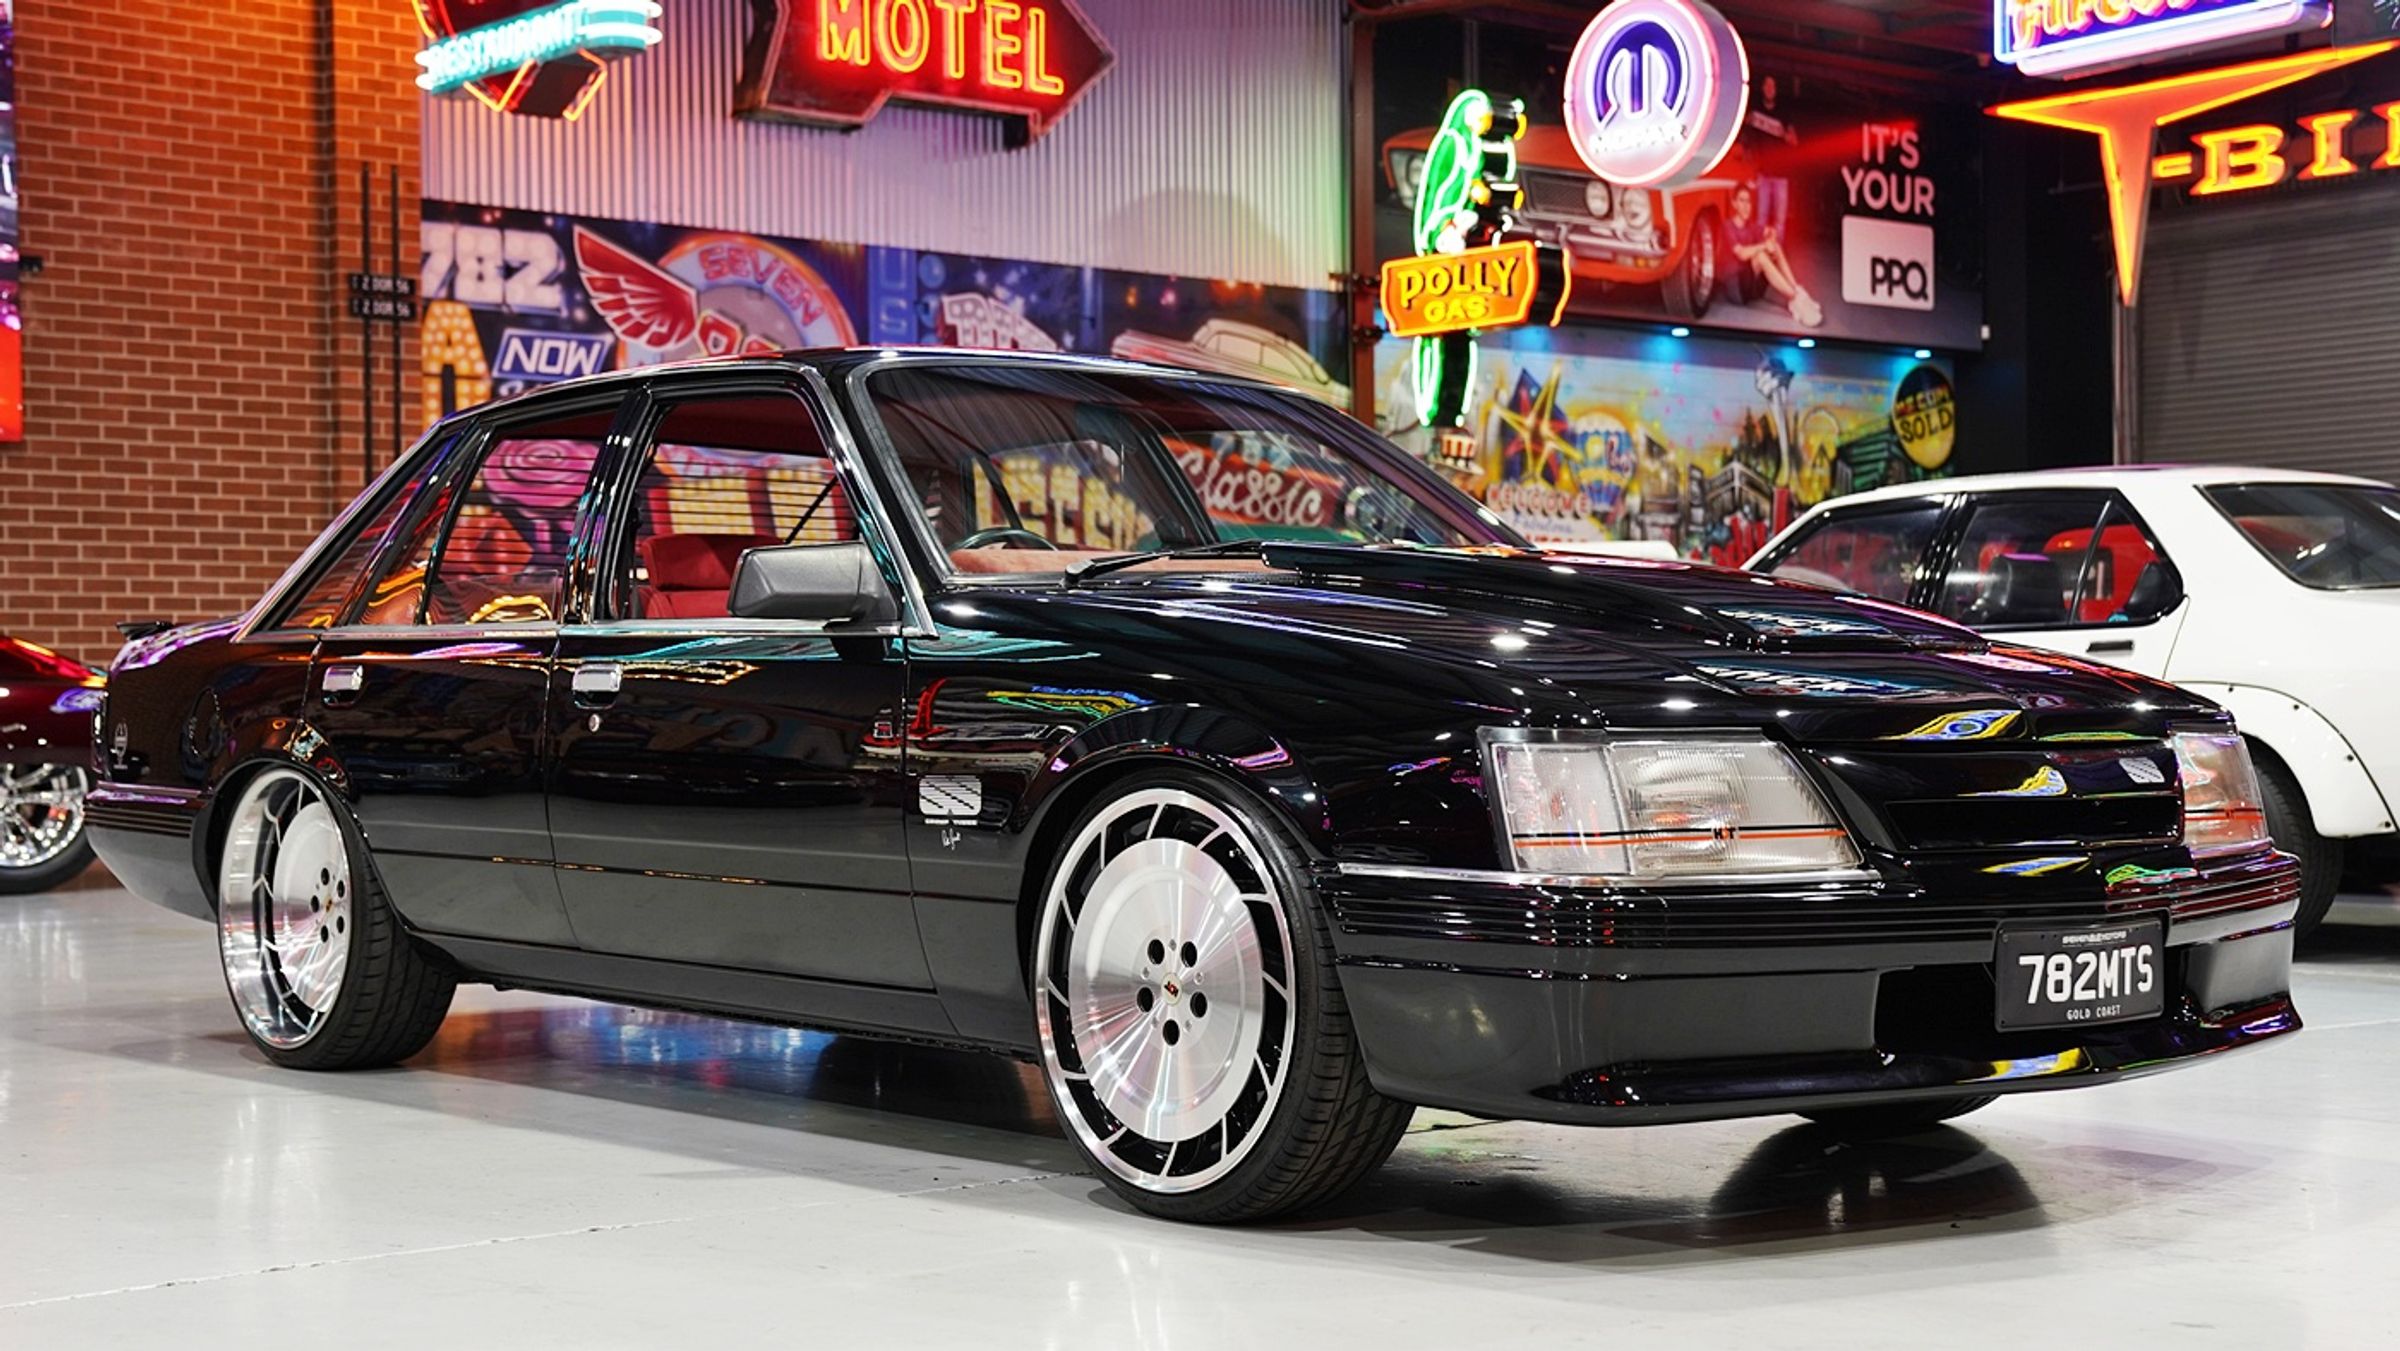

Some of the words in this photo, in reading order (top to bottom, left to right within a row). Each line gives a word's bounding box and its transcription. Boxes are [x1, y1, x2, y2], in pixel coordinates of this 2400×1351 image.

[819, 0, 1064, 96] MOTEL
[1861, 122, 1920, 170] IT'S
[1840, 165, 1935, 216] YOUR
[421, 221, 567, 316] 782
[698, 246, 825, 327] SEVEN
[1396, 256, 1521, 311] POLLY
[1871, 255, 1929, 301] PPQ
[1423, 294, 1491, 324] GAS
[501, 336, 602, 376] NOW
[1900, 407, 1952, 443] SOLD
[1176, 450, 1324, 528] Classic
[2018, 944, 2153, 1004] 782MTS
[2065, 1008, 2092, 1021] GOLD
[2096, 1004, 2122, 1018] COAST
